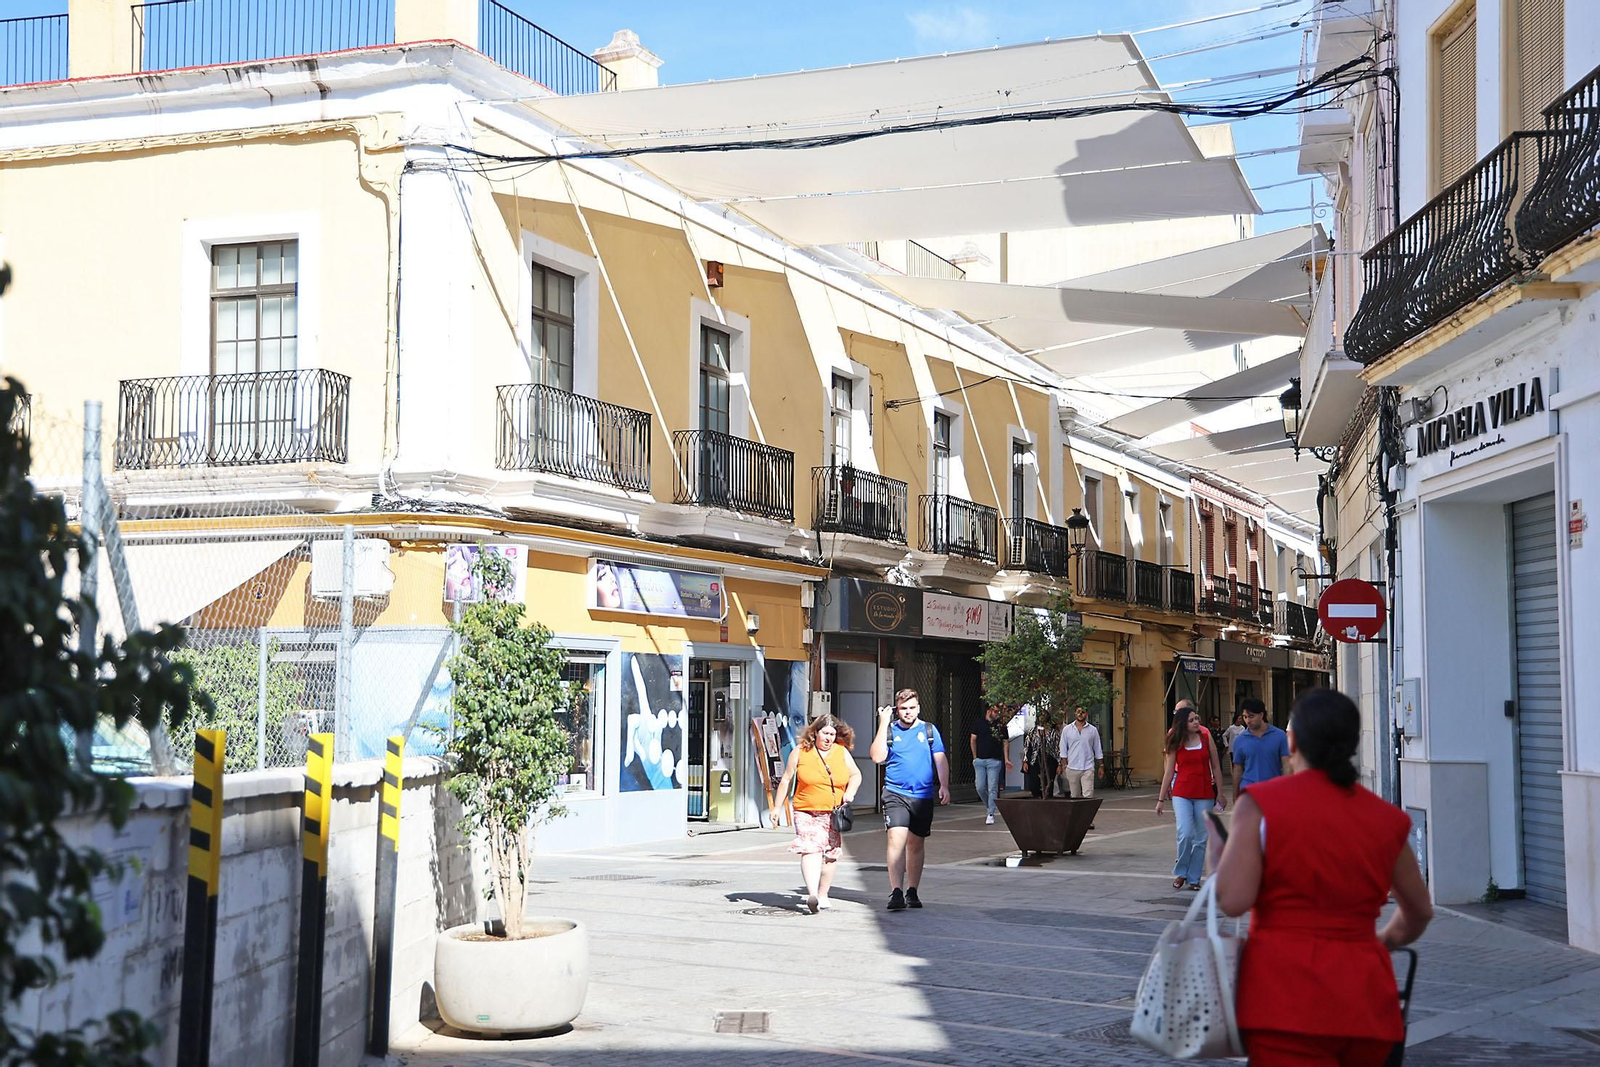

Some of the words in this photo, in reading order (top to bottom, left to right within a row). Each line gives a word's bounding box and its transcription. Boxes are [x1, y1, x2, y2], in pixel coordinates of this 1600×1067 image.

[1417, 402, 1487, 458] MICAELA
[1488, 377, 1544, 429] VILLA
[872, 604, 897, 613] ESTUDIO
